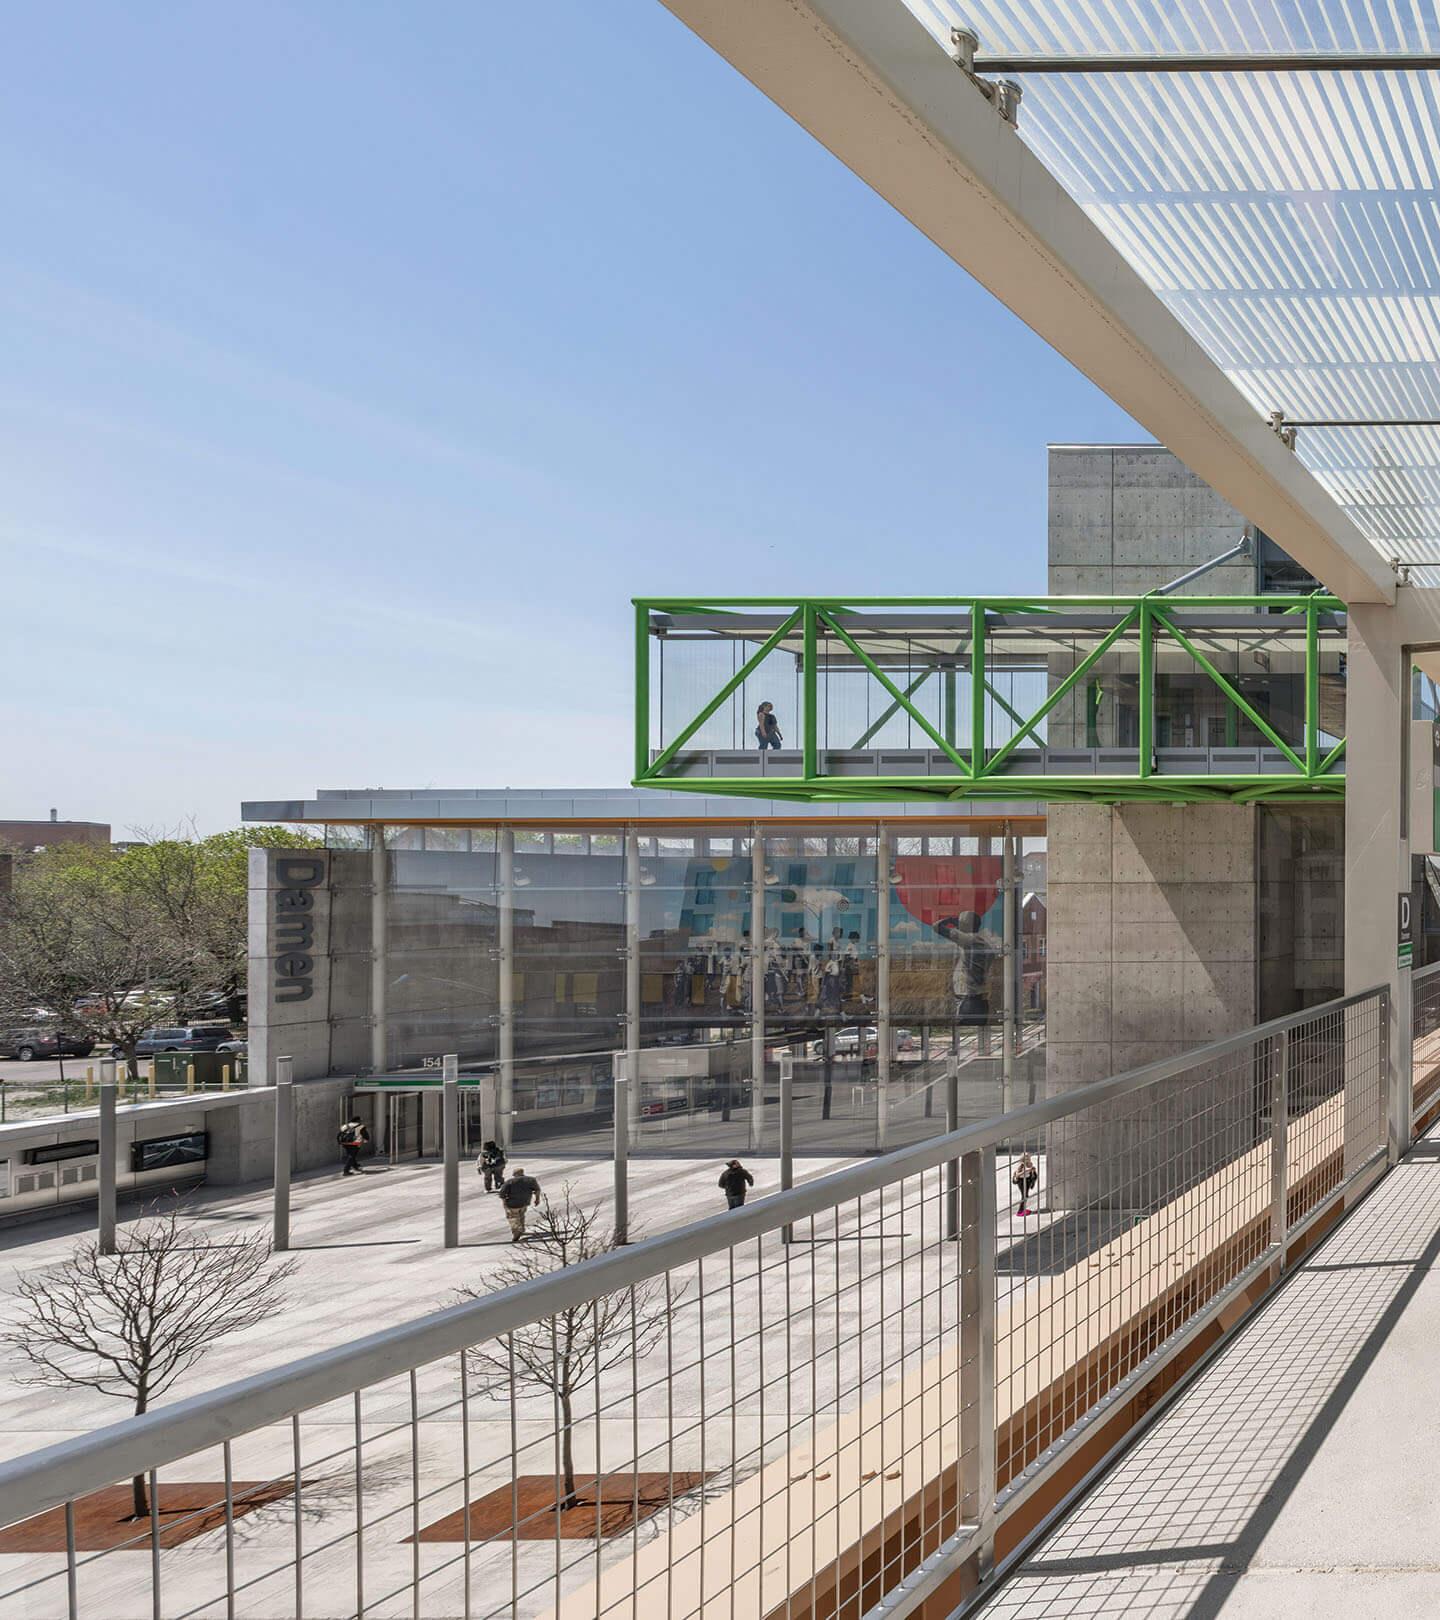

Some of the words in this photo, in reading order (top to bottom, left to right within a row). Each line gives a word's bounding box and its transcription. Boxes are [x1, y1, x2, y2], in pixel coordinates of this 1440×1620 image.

[1401, 896, 1410, 929] D
[275, 859, 324, 1003] Damen
[422, 1057, 441, 1067] 154
